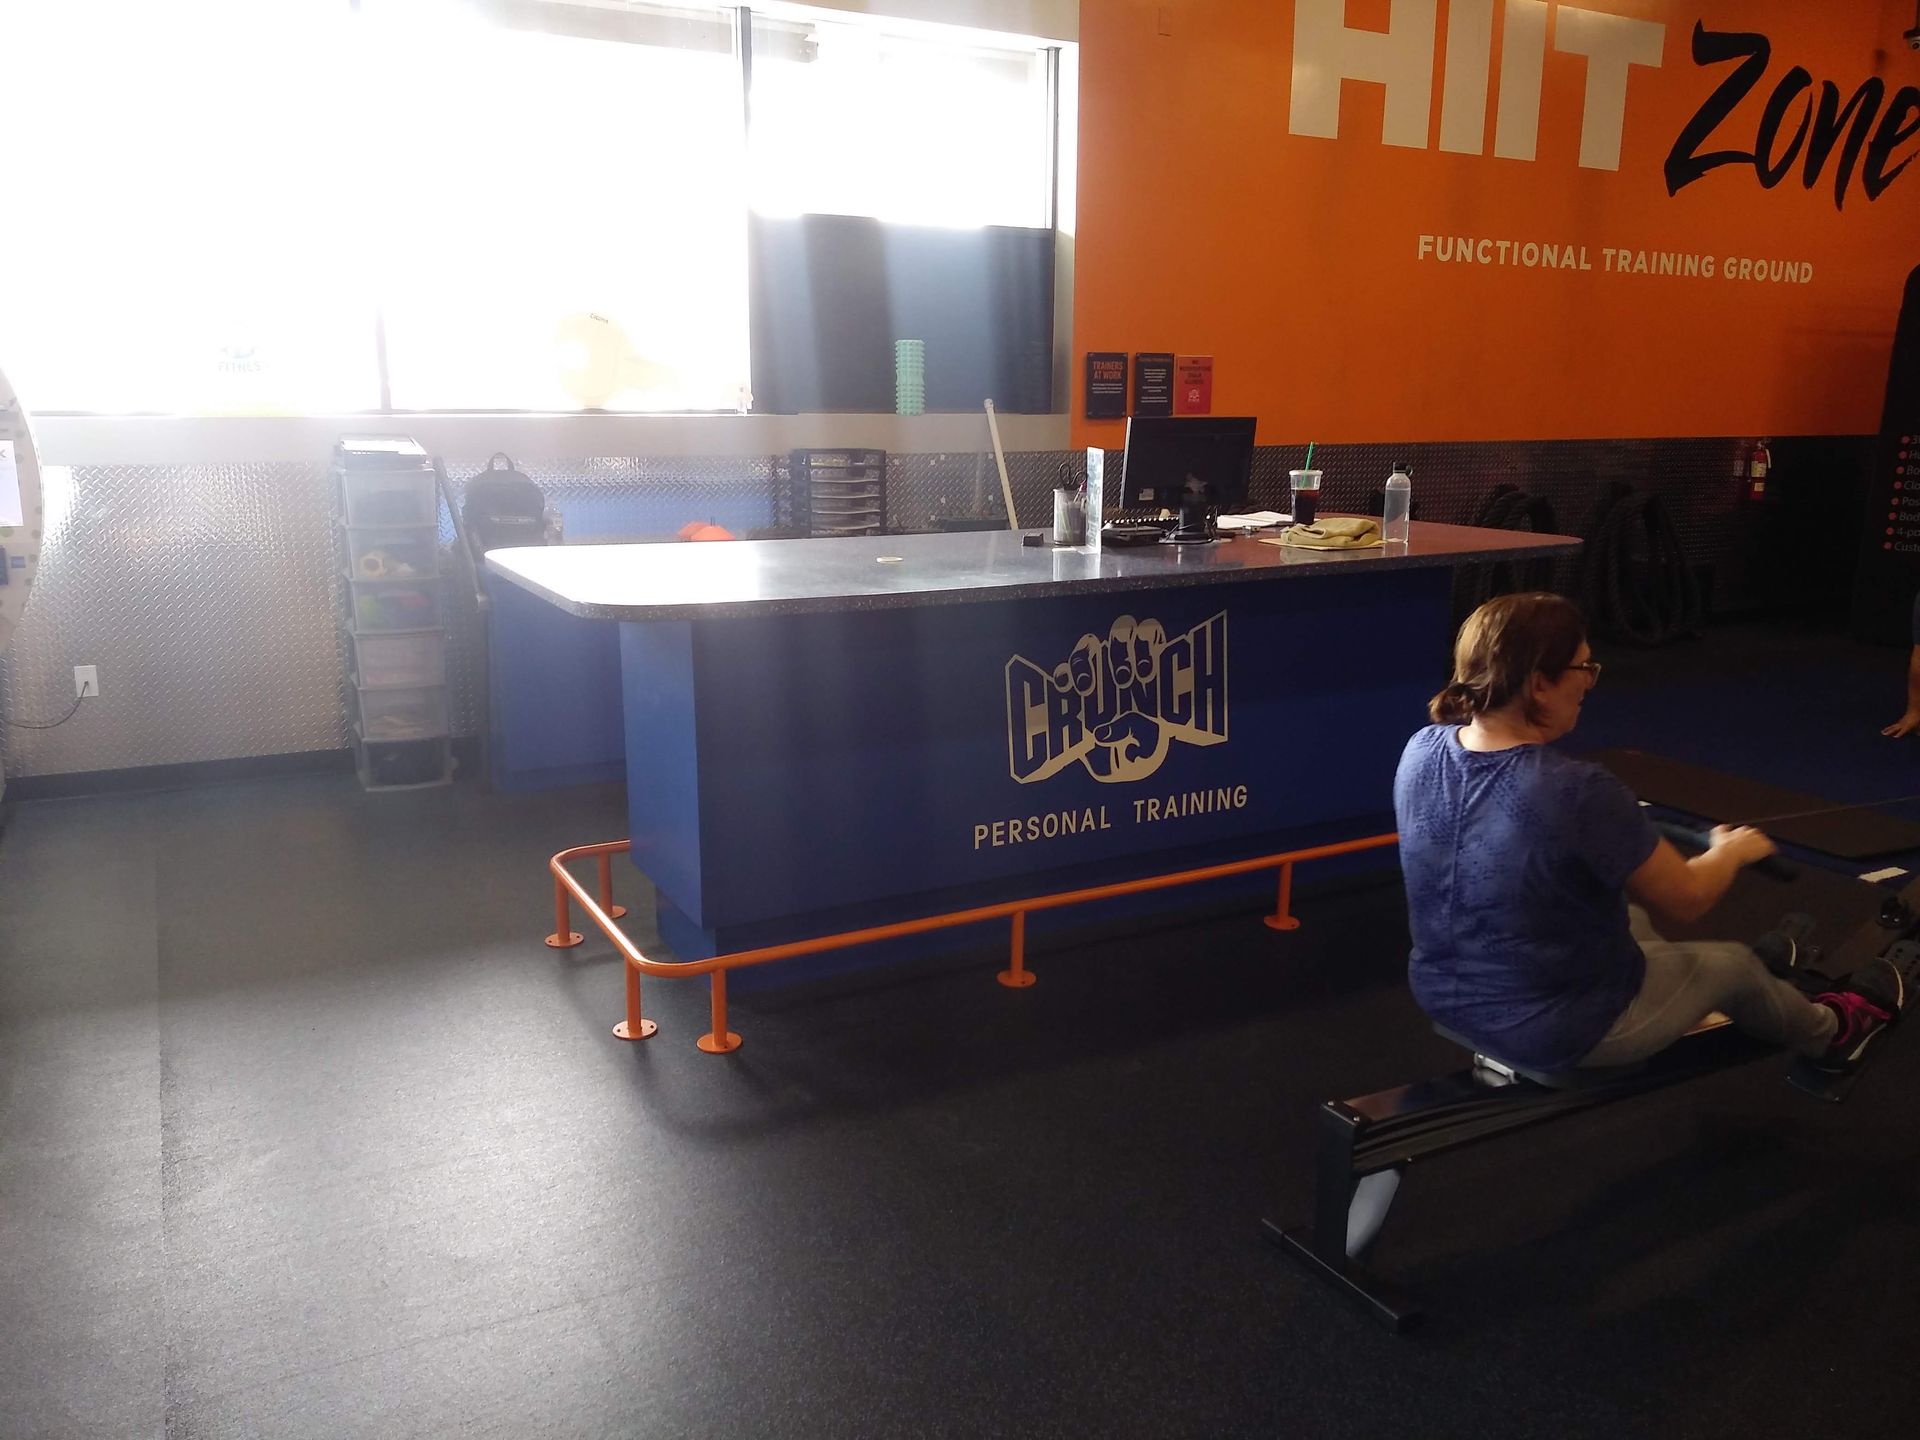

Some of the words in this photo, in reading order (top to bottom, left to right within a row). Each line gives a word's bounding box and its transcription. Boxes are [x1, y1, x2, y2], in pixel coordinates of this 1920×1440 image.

[1289, 0, 1666, 171] HIIT
[1664, 19, 1920, 211] Zone
[1417, 235, 1592, 271] FUNCTIONAL
[1603, 247, 1715, 279] TRAINING
[1723, 256, 1814, 284] GROUND
[1004, 609, 1228, 784] CRUNCH
[974, 805, 1111, 850] PERSONAL
[1133, 784, 1248, 824] TRAINING
